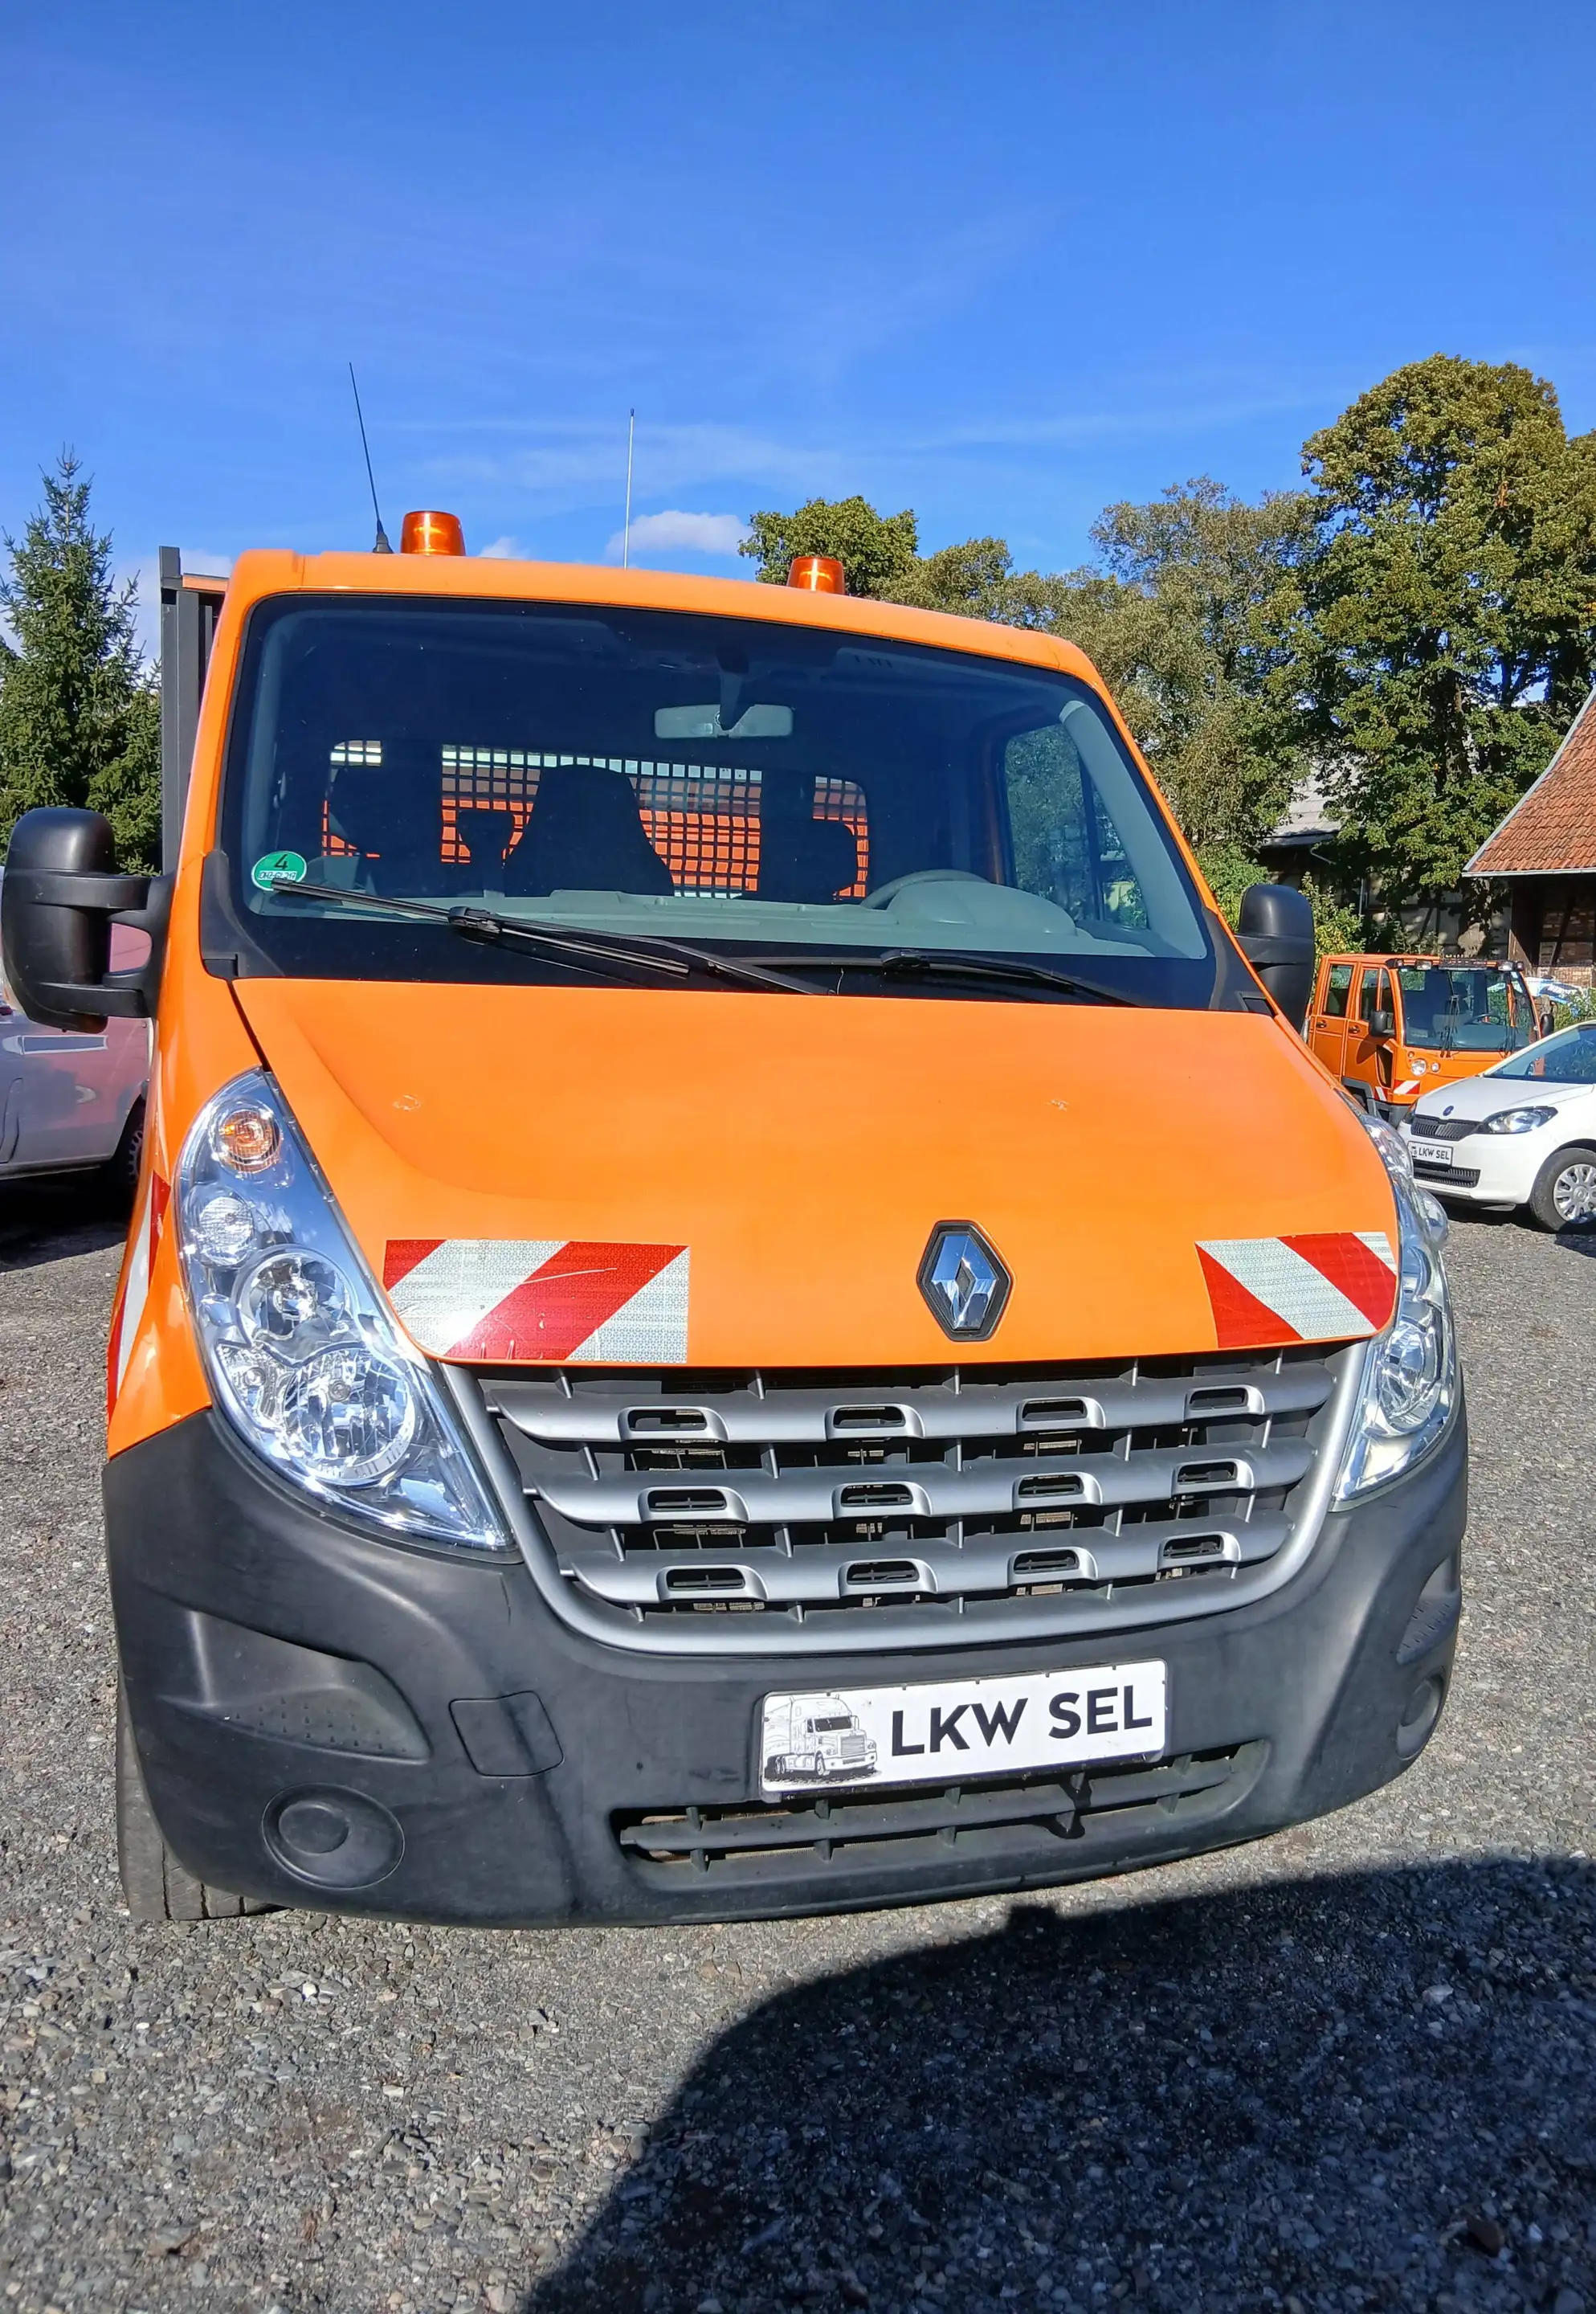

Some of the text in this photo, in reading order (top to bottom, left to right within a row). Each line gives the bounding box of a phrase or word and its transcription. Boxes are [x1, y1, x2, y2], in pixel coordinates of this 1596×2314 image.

[274, 853, 288, 871] 4
[1418, 1147, 1450, 1160] LKW SEL
[892, 1685, 1153, 1756] LKW SEL
